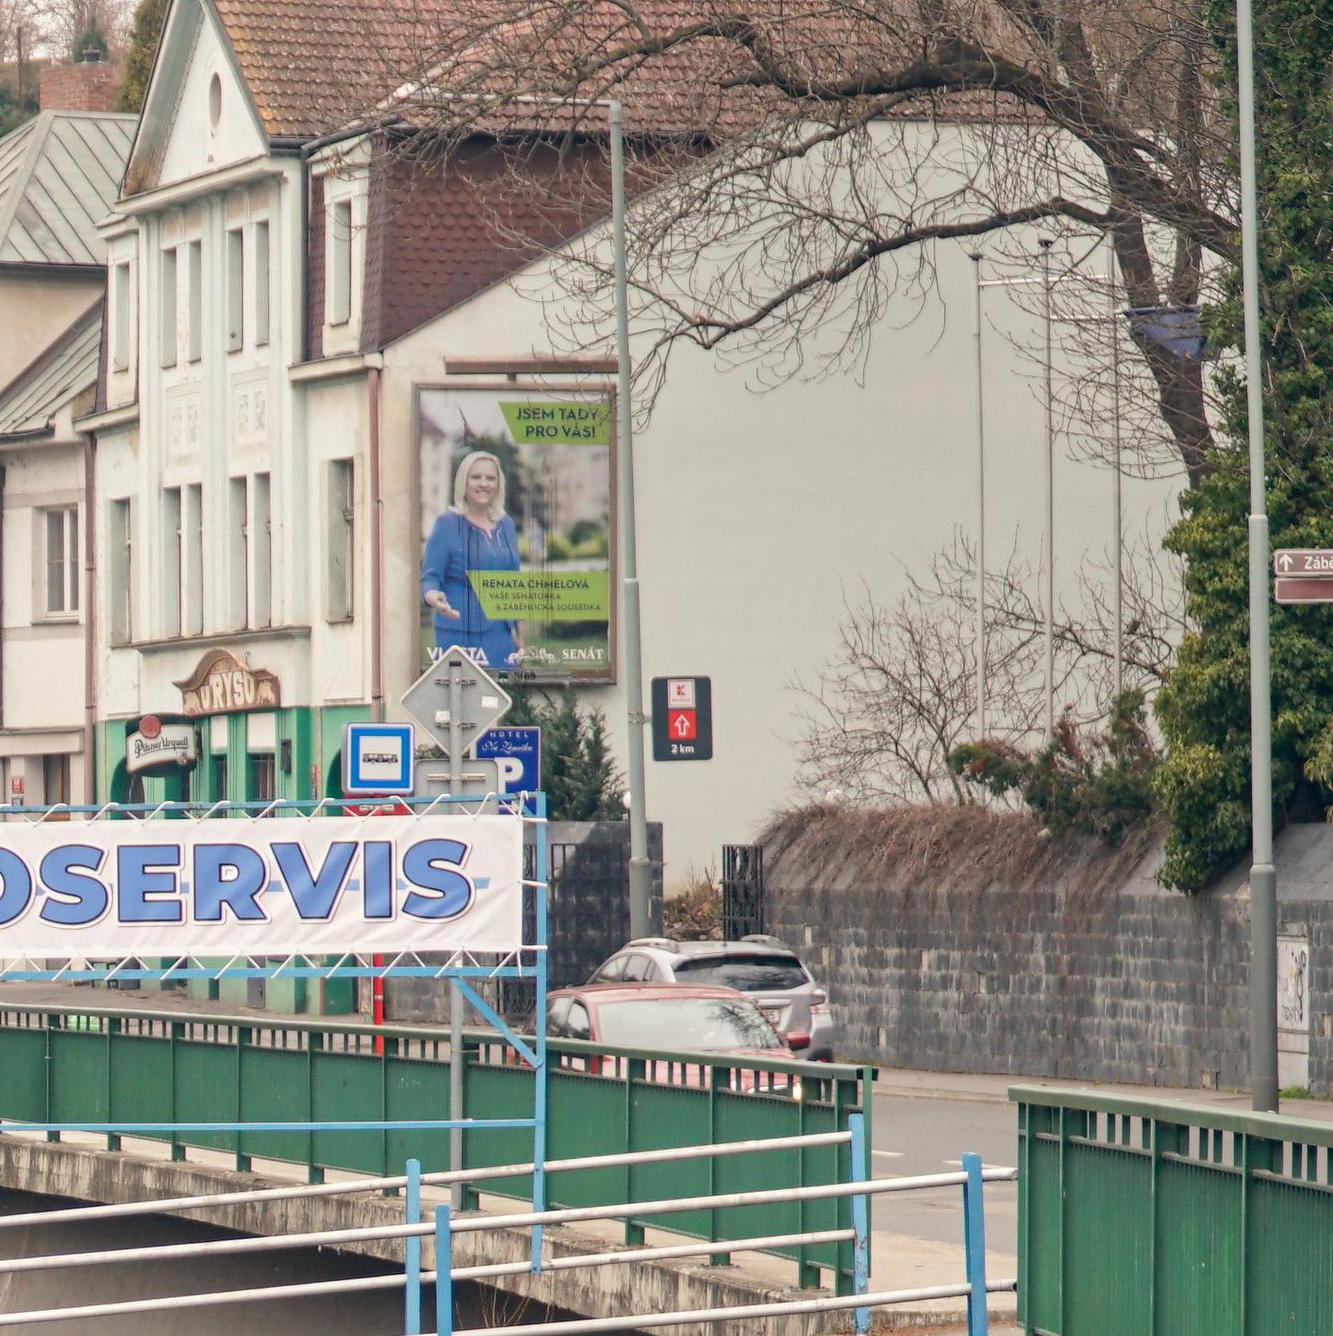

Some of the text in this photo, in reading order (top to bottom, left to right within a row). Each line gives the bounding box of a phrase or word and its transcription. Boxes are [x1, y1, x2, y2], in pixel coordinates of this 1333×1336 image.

[517, 407, 598, 420] JSEM TADY
[526, 425, 558, 437] PRO
[483, 579, 525, 588] RENATA
[562, 646, 604, 660] SENÁT
[161, 736, 189, 751] Urquell
[671, 744, 694, 753] 2 km
